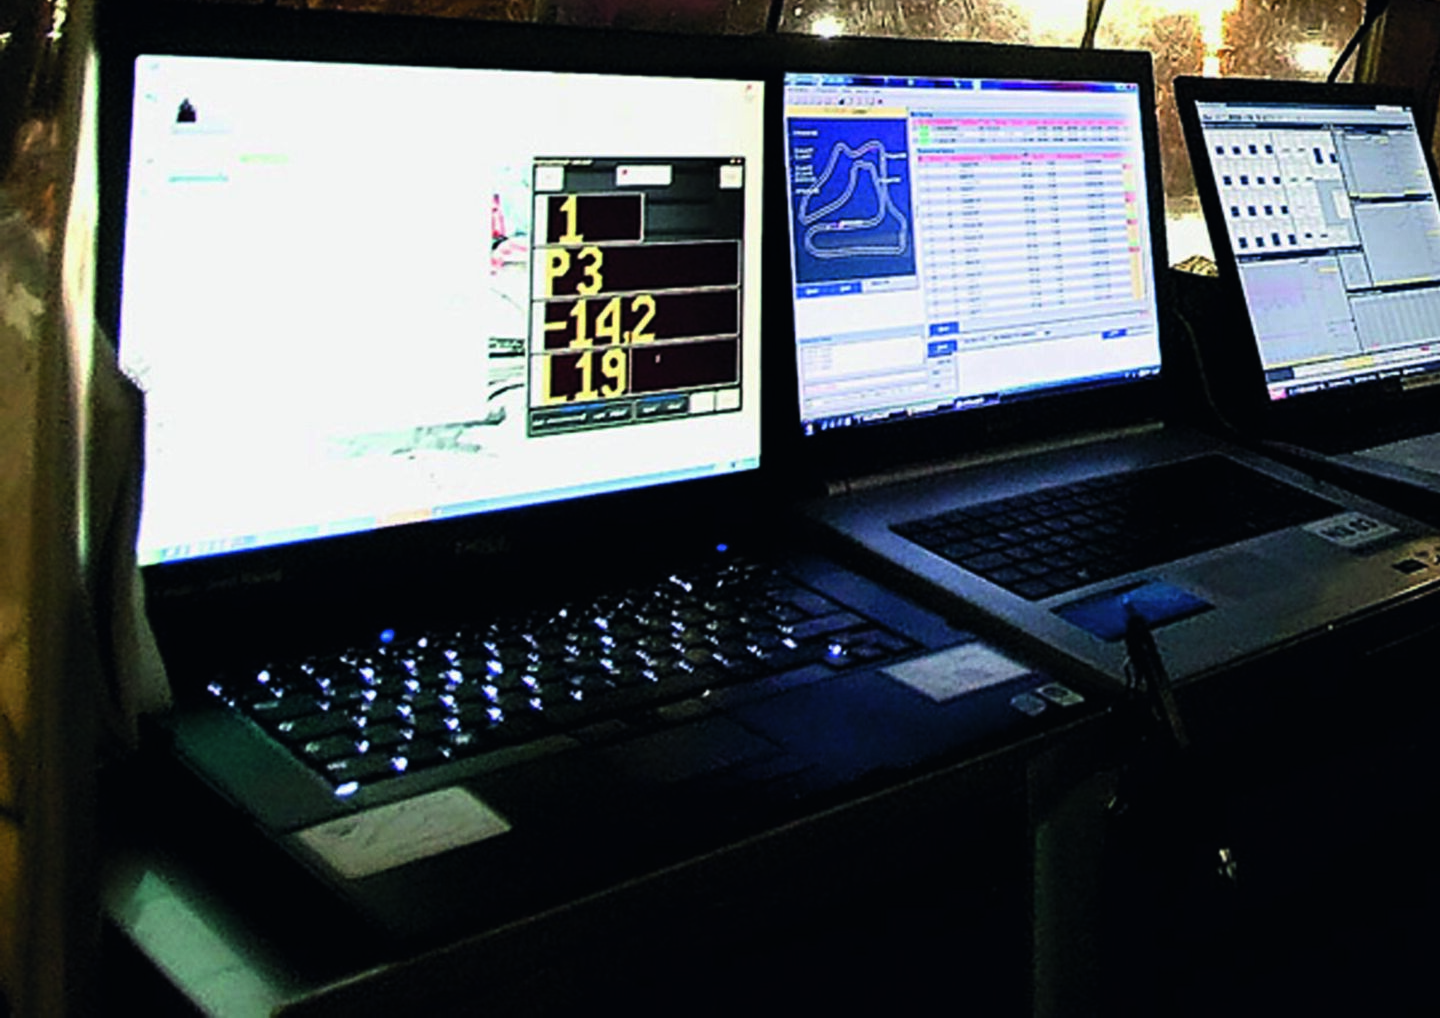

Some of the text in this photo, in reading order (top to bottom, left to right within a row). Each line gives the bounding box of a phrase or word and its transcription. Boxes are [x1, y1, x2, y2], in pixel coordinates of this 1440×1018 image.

[559, 194, 583, 244] 1
[545, 246, 603, 296] P3
[542, 348, 627, 403] L19
